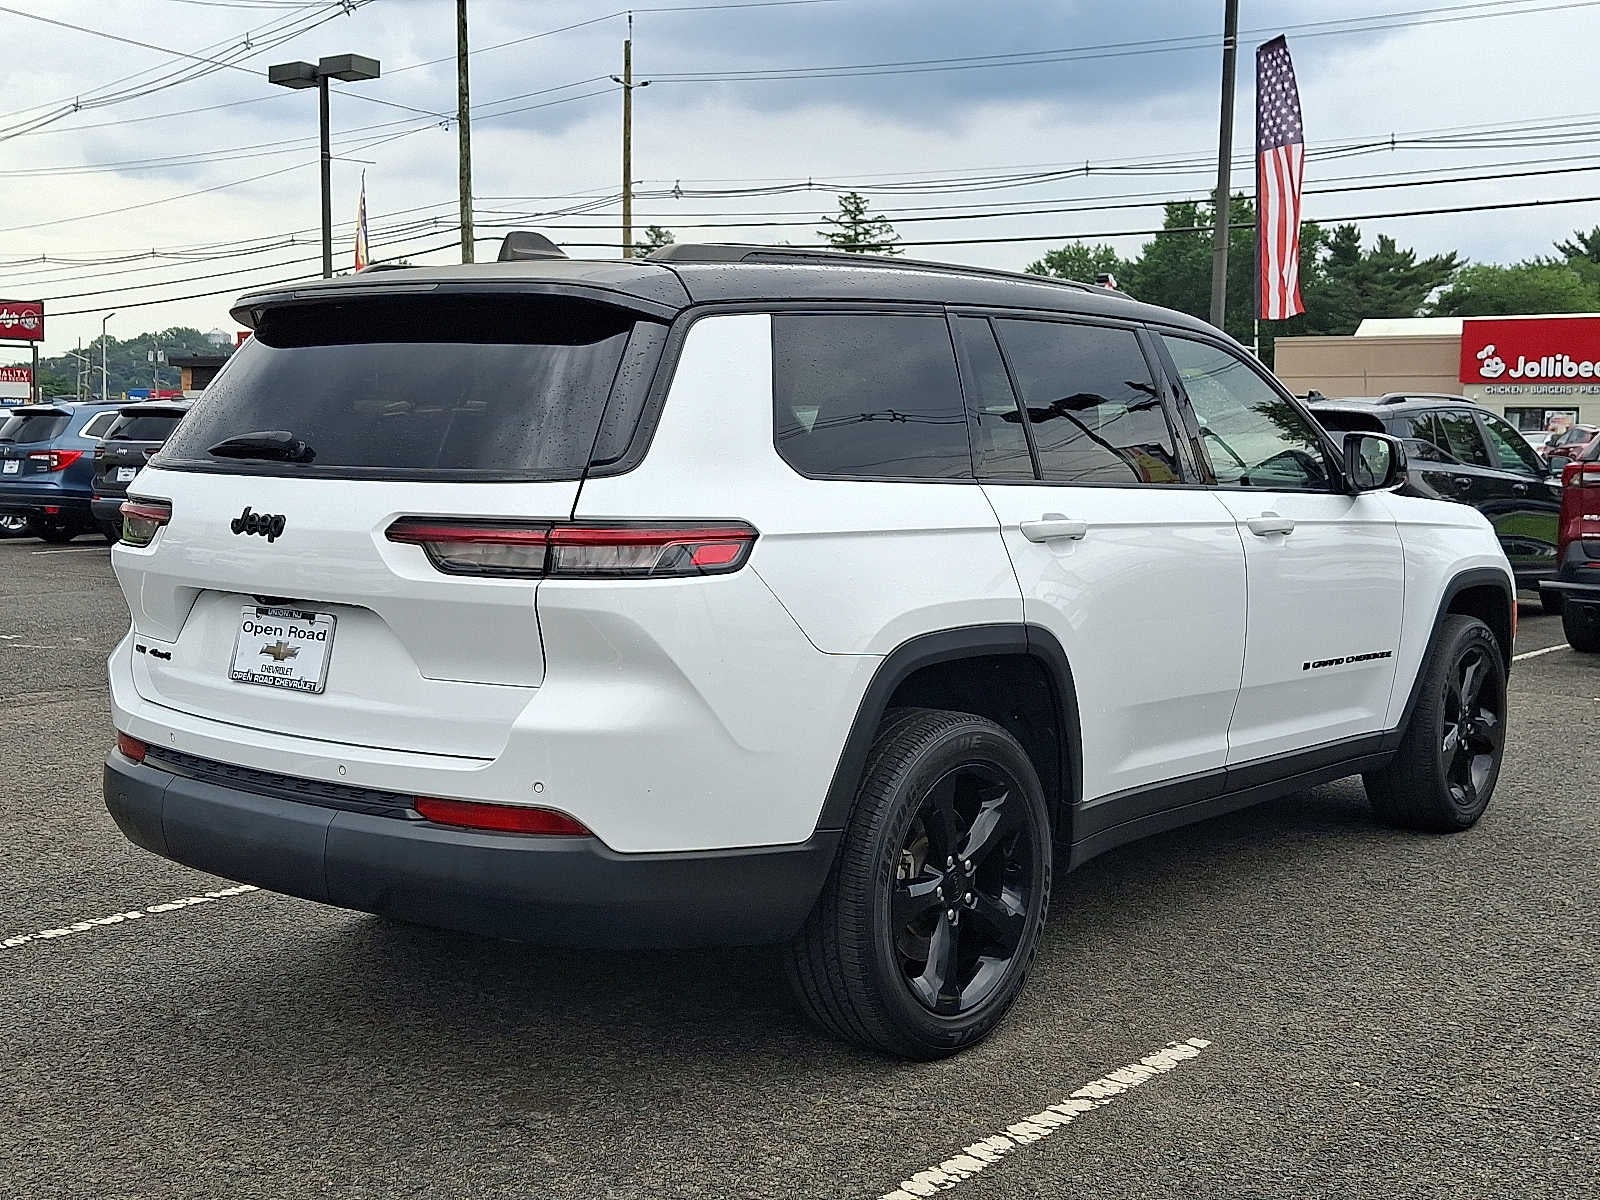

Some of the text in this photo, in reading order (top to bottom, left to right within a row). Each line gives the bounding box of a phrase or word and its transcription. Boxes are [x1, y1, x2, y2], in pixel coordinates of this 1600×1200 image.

[0, 369, 28, 377] ALITY
[1484, 385, 1523, 394] CHICKEN
[1530, 385, 1572, 394] BURGERS
[231, 506, 286, 543] Jeep
[243, 621, 327, 642] Open Road
[1312, 650, 1392, 669] GRAND CHEROKEE
[260, 664, 293, 677] CHEVROLET
[232, 671, 315, 691] OPEN ROAD CHEVROLET
